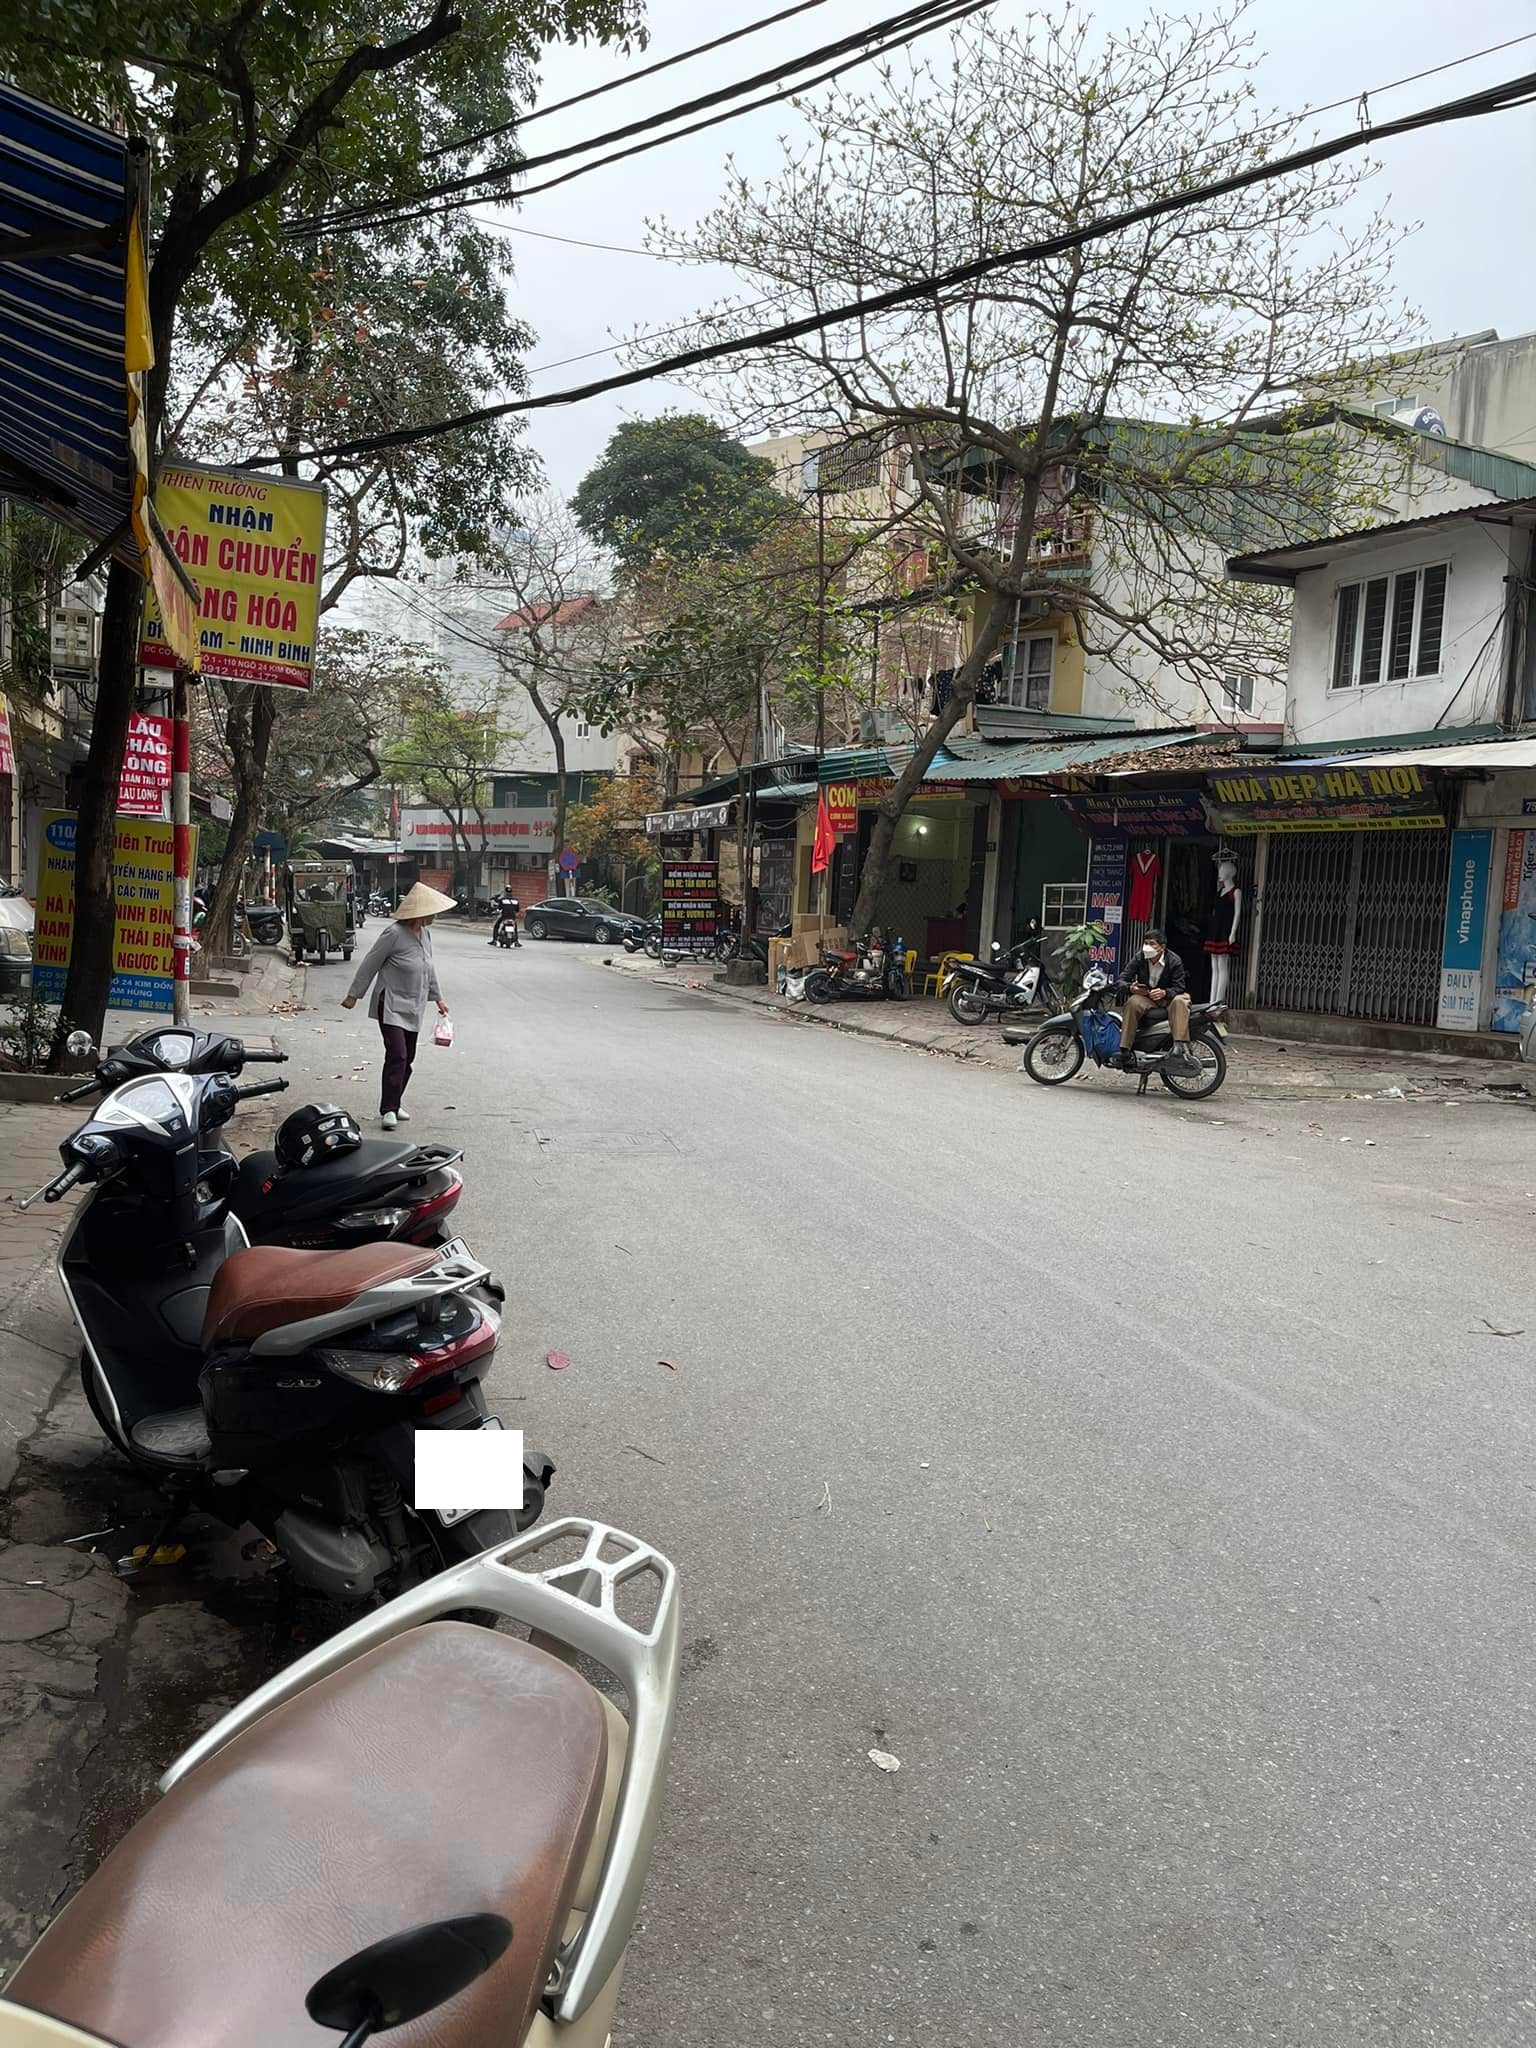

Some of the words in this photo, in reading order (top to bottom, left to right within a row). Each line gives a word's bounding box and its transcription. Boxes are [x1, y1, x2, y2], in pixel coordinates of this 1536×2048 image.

[207, 477, 268, 501] TRƯỜNG
[208, 503, 274, 533] NHẬN
[218, 537, 317, 585] CHUYỂN
[247, 591, 297, 633] HÓA
[240, 635, 274, 657] NINH
[278, 640, 310, 663] BÌNH
[223, 657, 237, 667] 110
[258, 662, 268, 672] 24
[269, 664, 285, 673] KIM
[1215, 774, 1267, 803] NHÀ
[1268, 774, 1318, 805] ĐẸP
[1323, 766, 1365, 798] HÀ
[1368, 766, 1423, 799] NỘI
[1091, 892, 1120, 908] MAY
[1457, 859, 1476, 944] vinaphone
[38, 919, 70, 938] NAM
[119, 926, 149, 945] THÁI
[1441, 995, 1456, 1009] SIM
